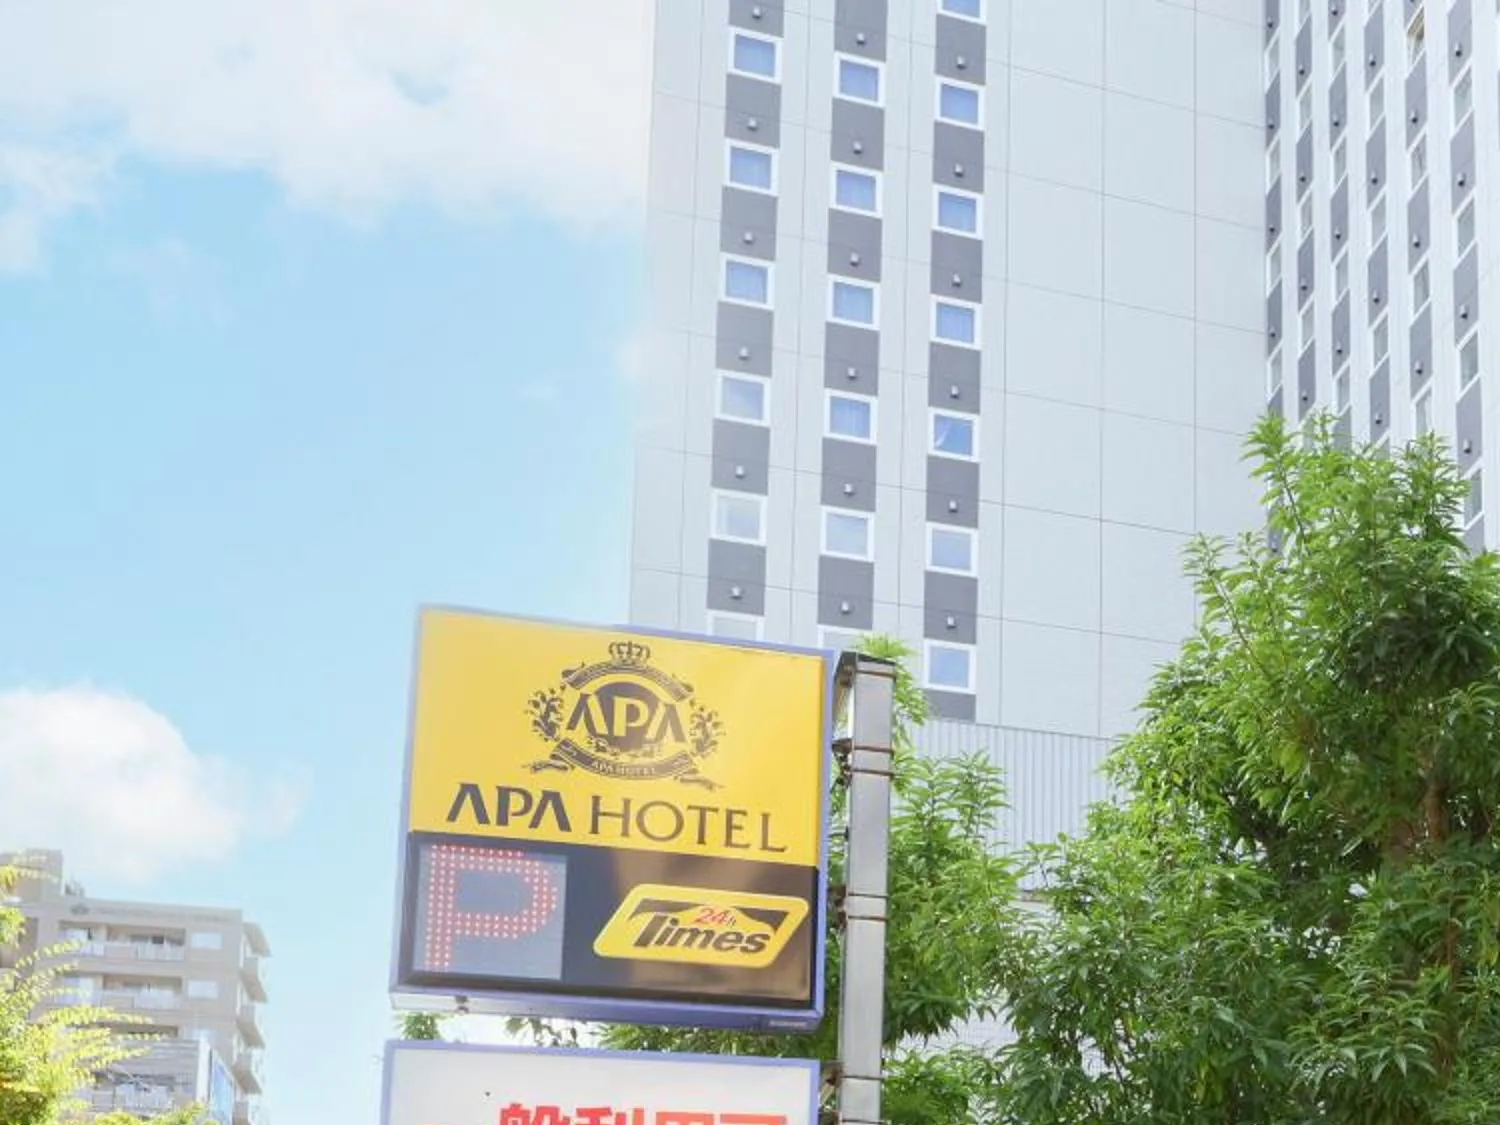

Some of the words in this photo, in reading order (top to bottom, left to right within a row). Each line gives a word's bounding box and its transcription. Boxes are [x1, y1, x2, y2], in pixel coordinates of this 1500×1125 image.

[566, 693, 687, 745] APA
[447, 783, 572, 832] APA
[589, 795, 789, 853] HOTEL
[422, 845, 557, 972] P
[633, 911, 771, 954] Times
